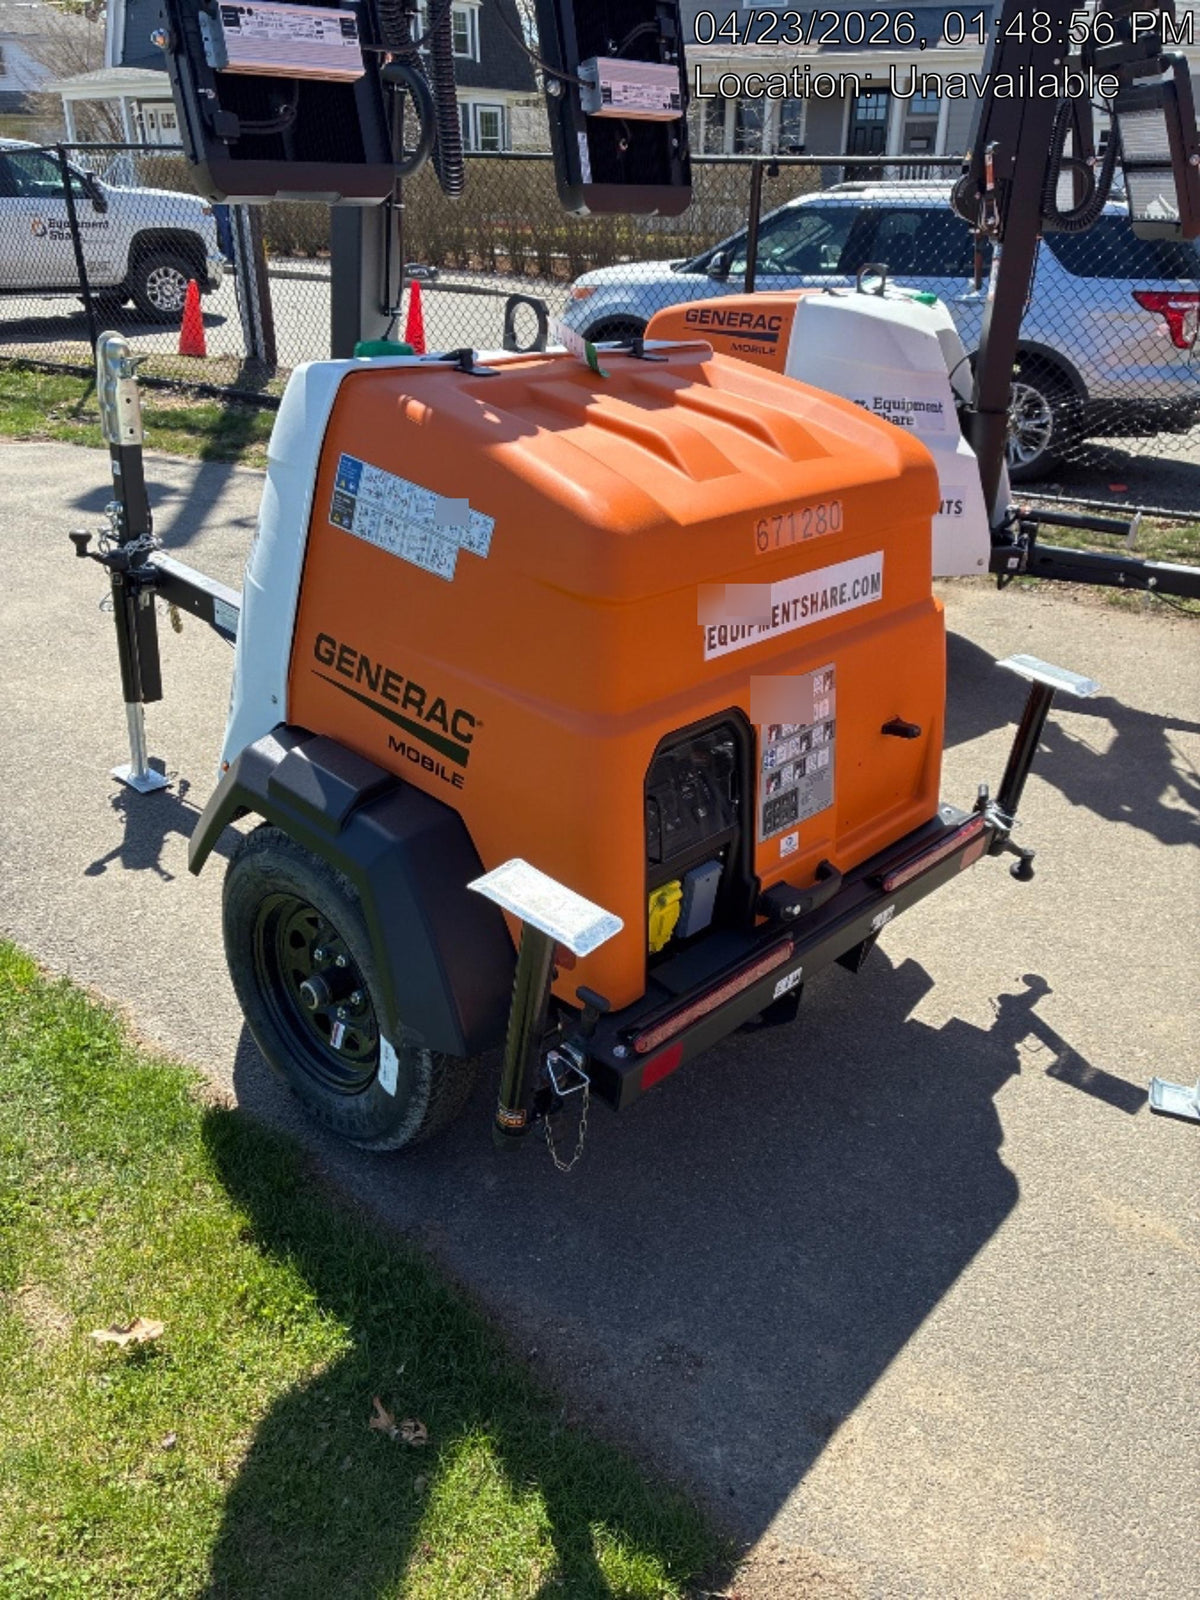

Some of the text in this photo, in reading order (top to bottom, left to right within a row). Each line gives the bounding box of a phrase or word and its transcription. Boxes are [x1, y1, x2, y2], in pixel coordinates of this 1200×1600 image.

[48, 219, 109, 229] Equment
[49, 230, 80, 240] Sha
[685, 308, 782, 331] GENERAC
[730, 342, 776, 356] MOBILE
[873, 396, 943, 414] Equipment
[873, 411, 915, 426] hare
[756, 500, 841, 552] 671280
[313, 632, 477, 744] GENERAC
[387, 734, 466, 790] MOBILE
